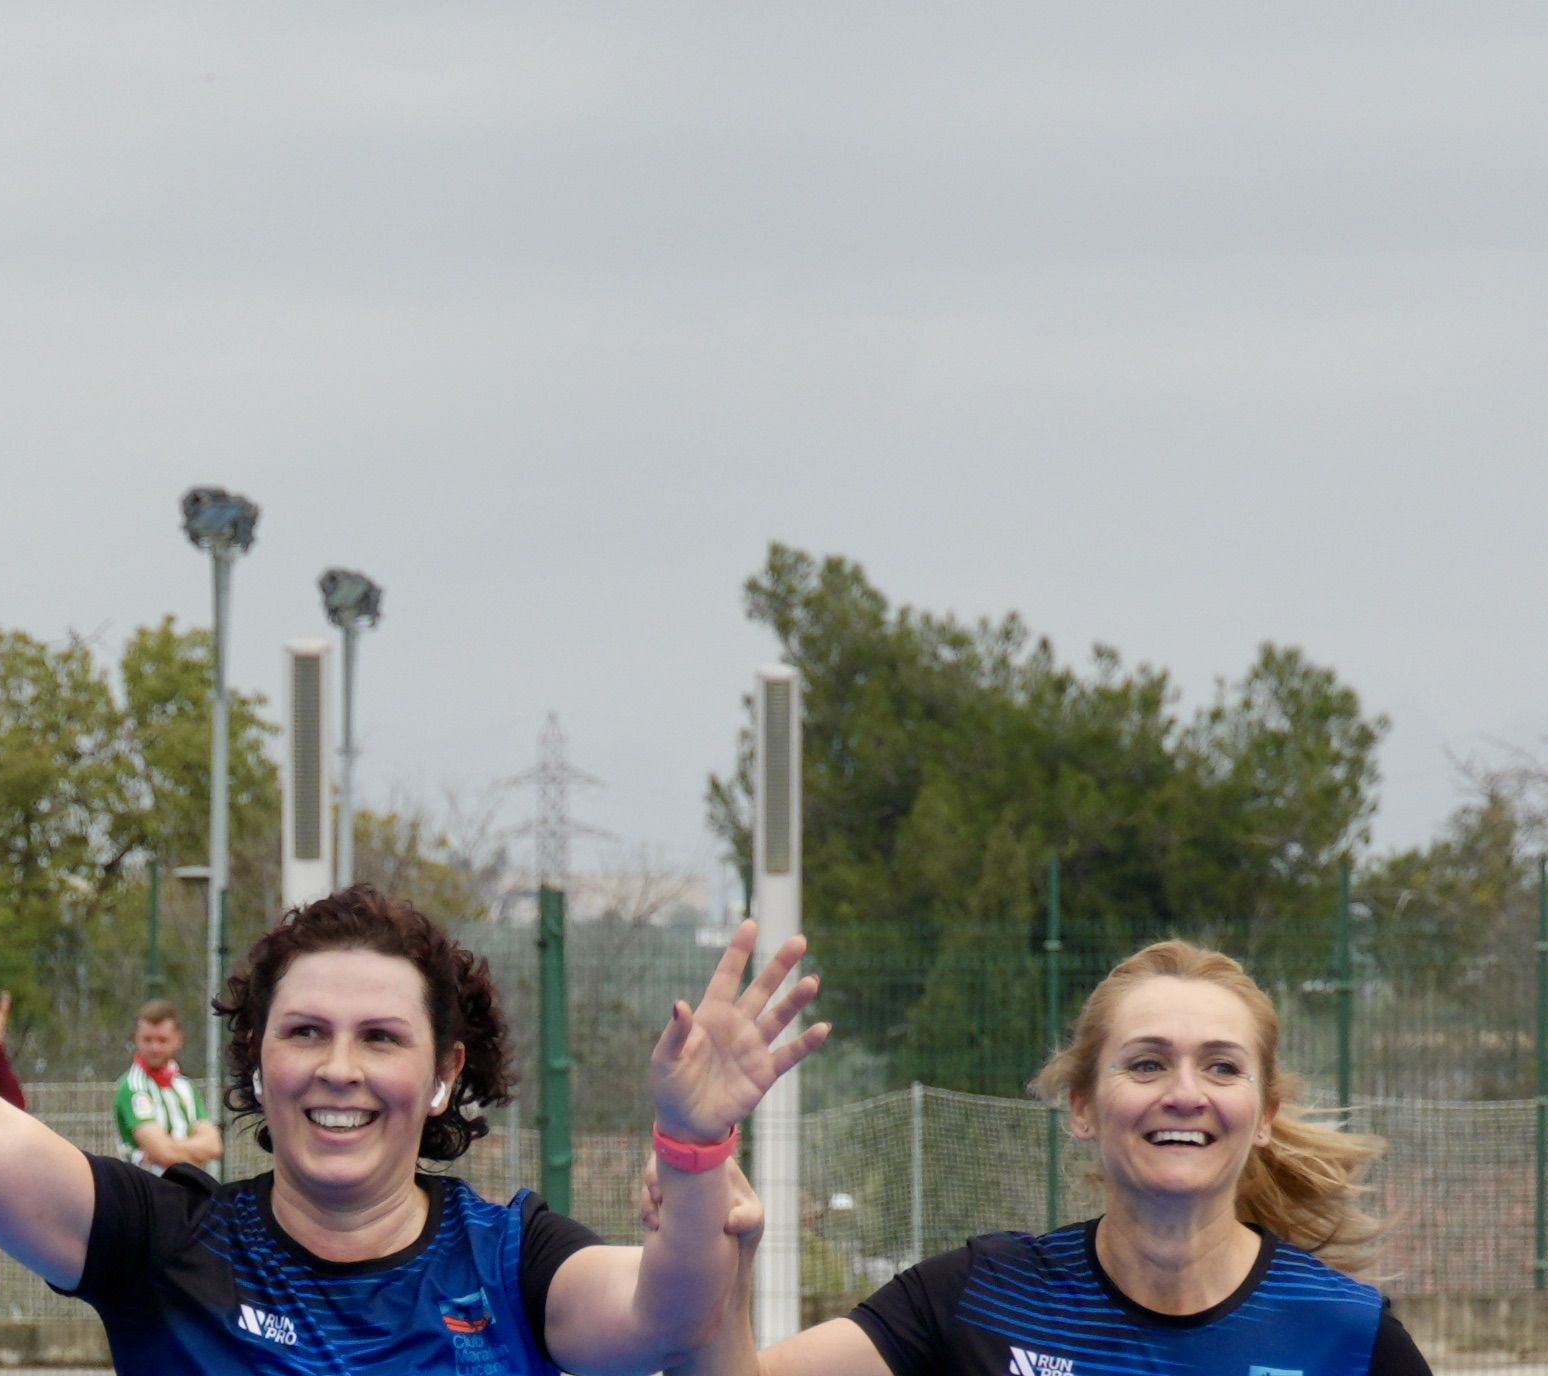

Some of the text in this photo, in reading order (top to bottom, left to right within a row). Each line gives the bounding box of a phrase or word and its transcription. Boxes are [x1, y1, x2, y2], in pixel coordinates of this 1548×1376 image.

[266, 1313, 295, 1331] RUN
[264, 1326, 298, 1346] PRO
[1037, 1355, 1074, 1372] RUN
